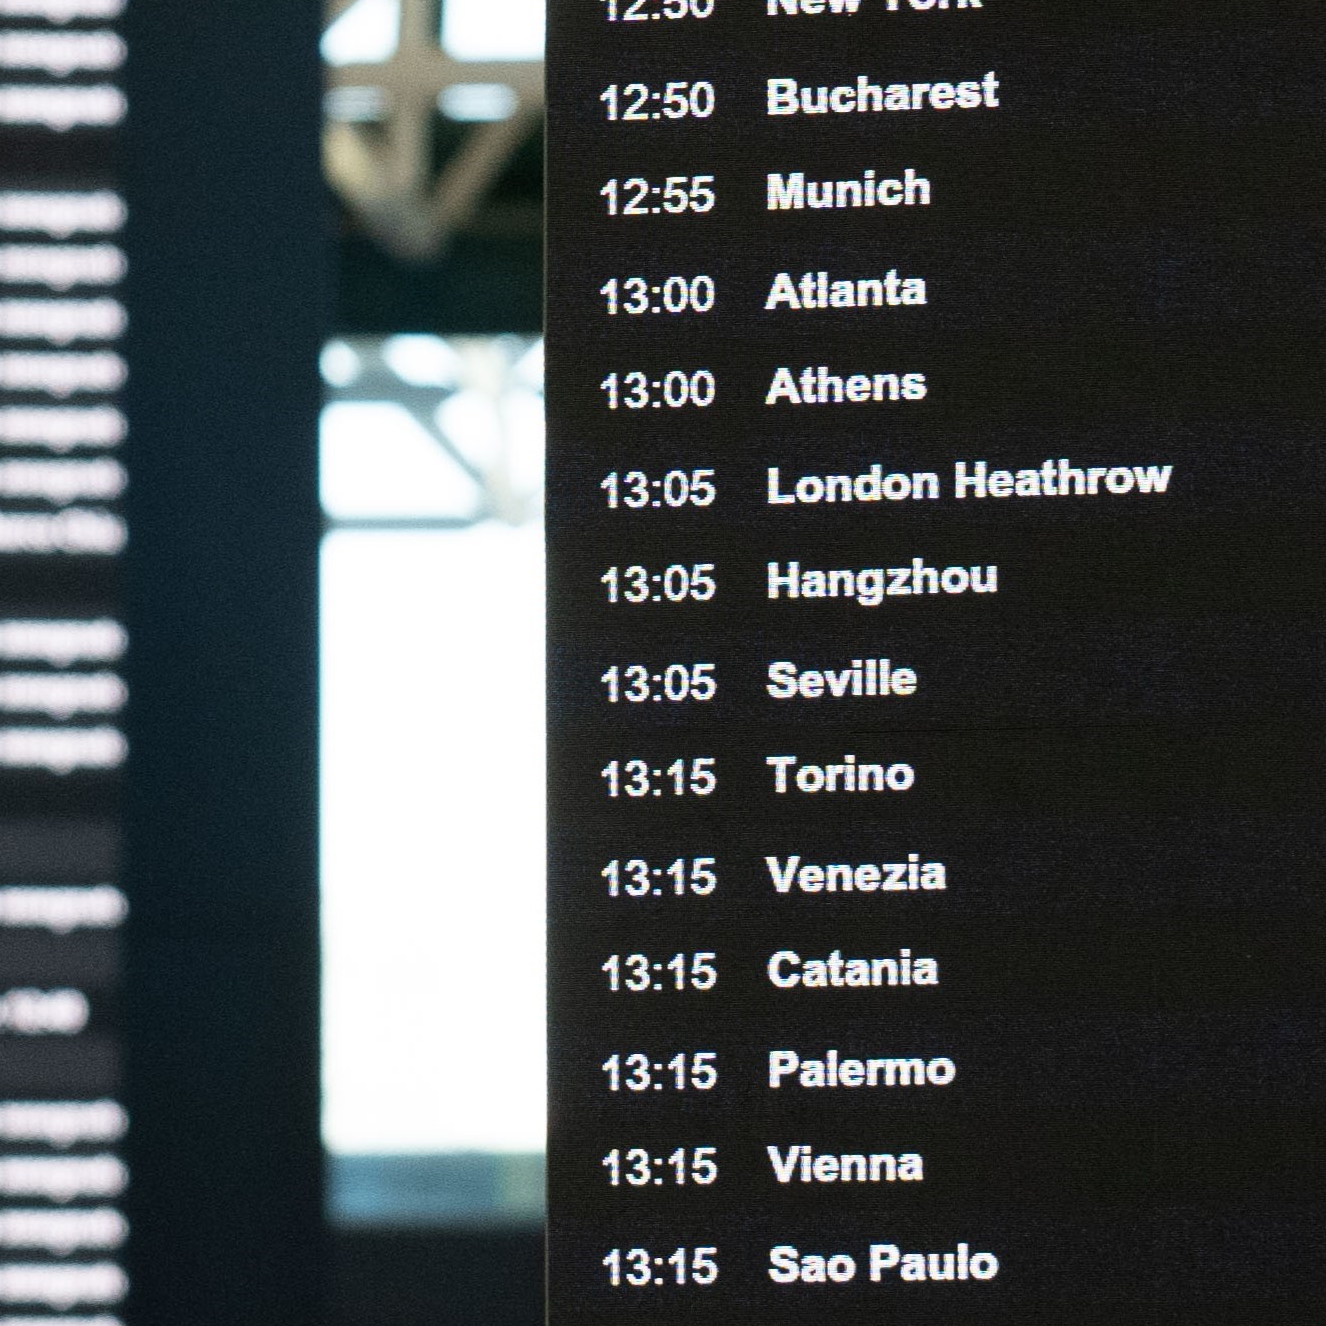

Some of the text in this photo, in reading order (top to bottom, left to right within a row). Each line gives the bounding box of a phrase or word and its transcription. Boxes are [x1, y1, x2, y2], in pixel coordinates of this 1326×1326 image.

[600, 82, 715, 120] 12:50
[767, 71, 999, 115] Bucharest
[600, 176, 715, 215] 12:55
[767, 169, 930, 210] Munich
[600, 276, 715, 314] 13:00
[765, 269, 927, 309] Atlanta
[601, 370, 715, 409] 13:00
[766, 367, 927, 404] Athens
[601, 470, 716, 508] 13:05
[768, 459, 1172, 504] London Heathrow
[601, 564, 716, 603] 13:05
[768, 558, 997, 606] Hangzhou
[601, 664, 716, 702] 13:05
[767, 659, 917, 698] Seville
[601, 758, 716, 797] 13:15
[766, 755, 914, 793] Torino
[602, 858, 716, 896] 13:15
[765, 854, 946, 893] Venezia
[602, 953, 717, 991] 13:15
[768, 949, 938, 988] Catania
[602, 1053, 717, 1091] 13:15
[769, 1050, 956, 1088] Palermo
[603, 1147, 717, 1186] 13:15
[767, 1146, 923, 1183] Vienna
[603, 1247, 718, 1286] 13:15
[769, 1243, 998, 1283] Sao Paulo
